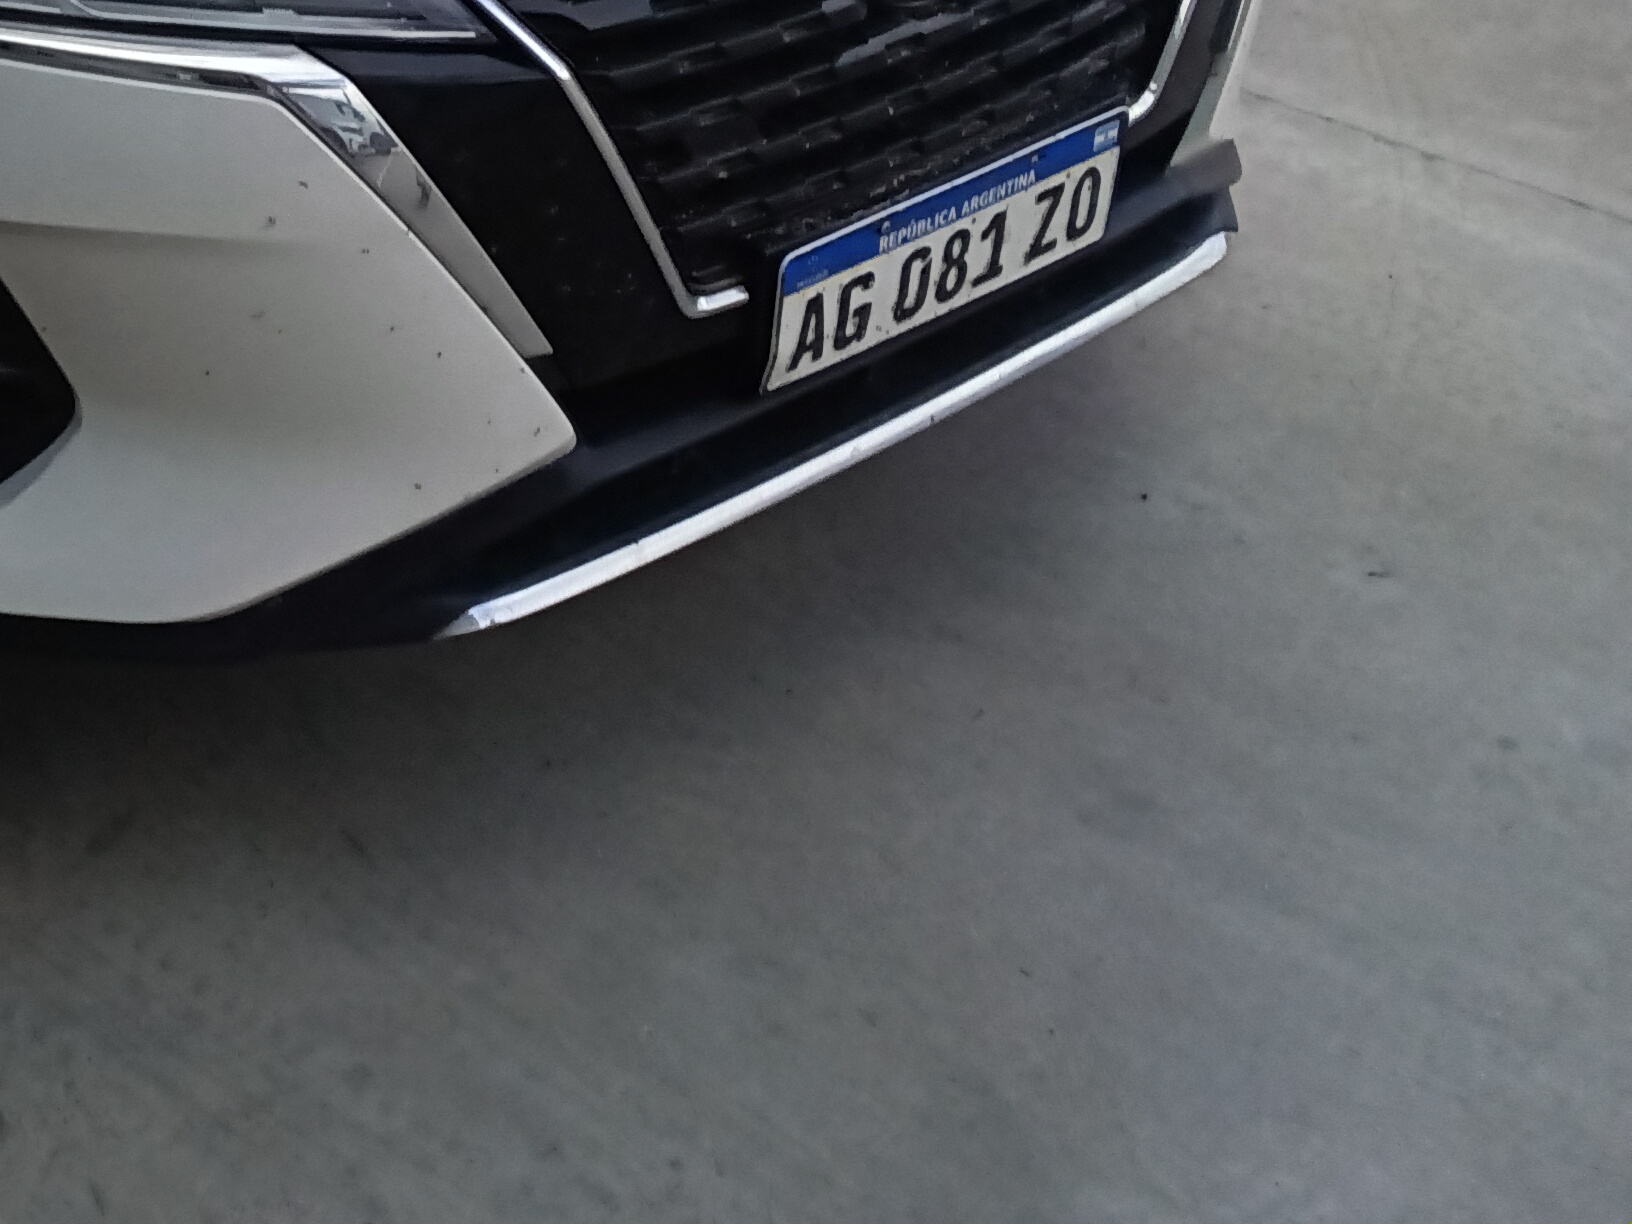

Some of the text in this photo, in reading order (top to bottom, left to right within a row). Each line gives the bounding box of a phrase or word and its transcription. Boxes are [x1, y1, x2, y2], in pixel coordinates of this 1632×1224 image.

[878, 169, 1036, 254] REPÚBLICA ARGENTINA
[786, 271, 876, 373] AG
[893, 206, 1010, 325] 081
